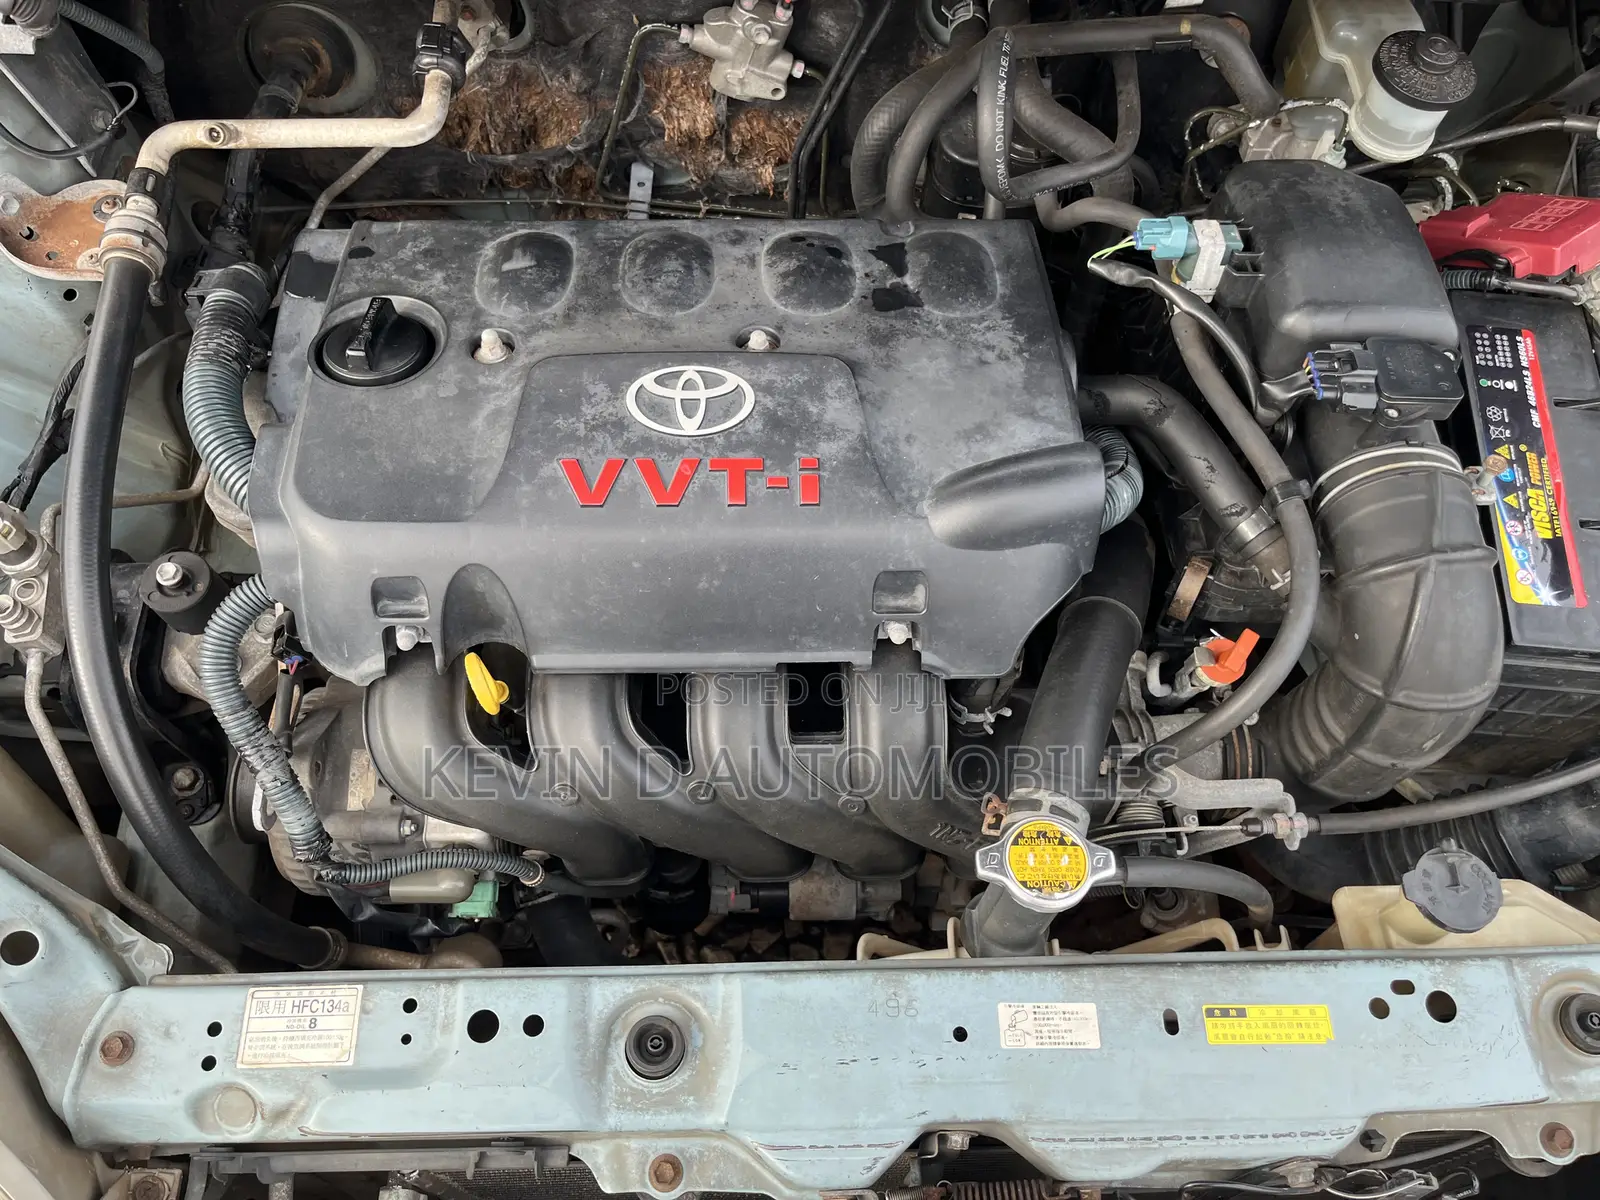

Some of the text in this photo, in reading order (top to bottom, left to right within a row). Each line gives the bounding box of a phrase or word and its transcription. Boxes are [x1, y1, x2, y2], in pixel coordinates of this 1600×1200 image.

[999, 54, 1010, 78] FUEL
[995, 109, 1005, 131] NOT
[995, 134, 1005, 151] DO
[1526, 452, 1542, 486] POWER
[1541, 457, 1554, 495] CERTIFIED
[559, 457, 822, 507] VVT-i
[1527, 488, 1554, 539] VISCA
[1018, 838, 1060, 846] ATTENTION
[1026, 880, 1066, 889] CAUTION
[255, 999, 350, 1015] 限用 HFC134a
[308, 1017, 318, 1029] 8
